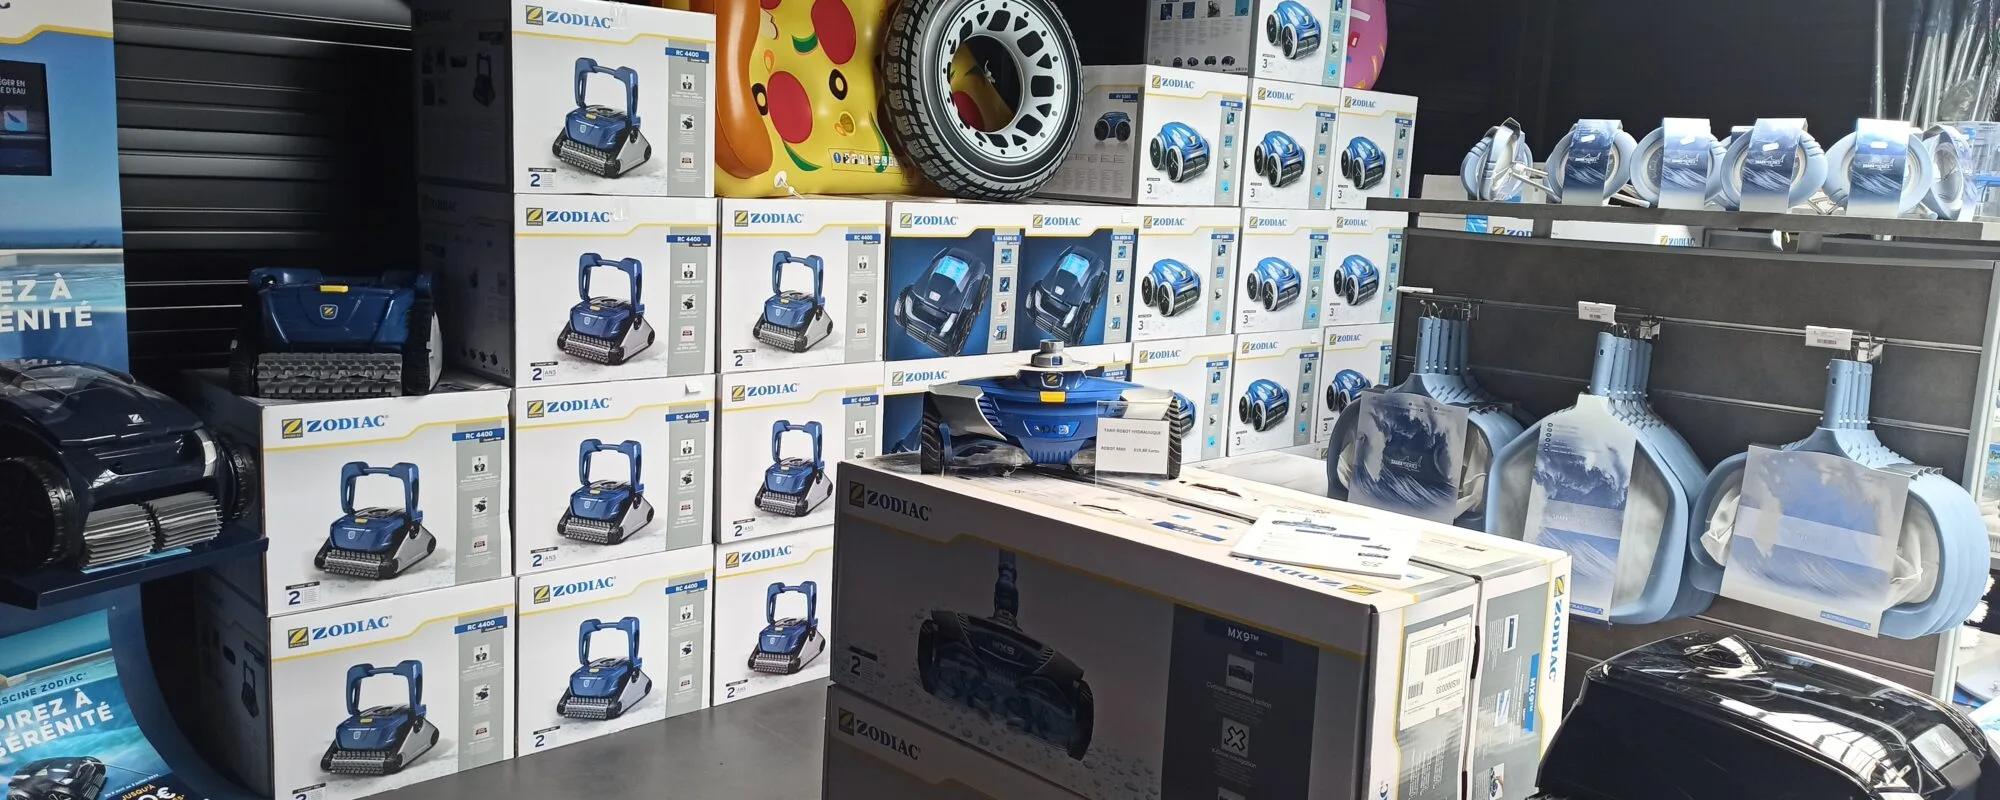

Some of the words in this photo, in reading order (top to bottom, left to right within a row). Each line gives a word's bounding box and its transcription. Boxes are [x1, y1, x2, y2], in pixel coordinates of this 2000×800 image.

[546, 11, 611, 29] ZODIAC
[1262, 58, 1268, 69] 3
[1162, 77, 1195, 89] ZODIAC
[1266, 90, 1294, 100] ZODIAC
[1352, 98, 1377, 108] ZODIAC
[530, 173, 541, 187] 2
[1146, 183, 1153, 194] 3
[1250, 188, 1256, 198] 3
[1337, 190, 1343, 199] 3
[546, 211, 610, 223] ZODIAC
[751, 213, 802, 224] ZODIAC
[914, 215, 957, 226] ZODIAC
[1044, 216, 1081, 226] ZODIAC
[1153, 217, 1185, 226] ZODIAC
[1258, 218, 1287, 227] ZODIAC
[1343, 218, 1368, 227] ZODIAC
[50, 272, 72, 300] À
[1329, 307, 1334, 317] 3
[1138, 320, 1144, 331] 3
[1243, 315, 1249, 324] 3
[1336, 334, 1362, 343] ZODIAC
[1250, 341, 1279, 351] ZODIAC
[735, 354, 743, 367] 2
[1149, 350, 1181, 360] ZODIAC
[532, 368, 542, 382] 2
[906, 371, 947, 382] ZODIAC
[747, 383, 798, 397] ZODIAC
[547, 398, 610, 413] ZODIAC
[307, 415, 385, 433] ZODIAC
[465, 432, 475, 440] RC
[1236, 437, 1241, 446] 3
[867, 490, 929, 521] ZODIAC
[734, 525, 743, 537] 2
[742, 545, 792, 562] ZODIAC
[532, 554, 542, 568] 2
[553, 577, 614, 597] ZODIAC
[684, 583, 698, 591] 4400
[288, 591, 301, 607] 2
[312, 616, 390, 641] ZODIAC
[467, 623, 477, 631] RC
[477, 619, 496, 629] 4400
[1548, 599, 1562, 682] ZODIAC
[851, 655, 861, 677] 2
[0, 687, 37, 706] SCINE
[41, 674, 82, 693] ZODIAC
[727, 686, 735, 698] 2
[75, 688, 93, 708] À
[534, 734, 545, 748] 2
[857, 719, 918, 760] ZODIAC
